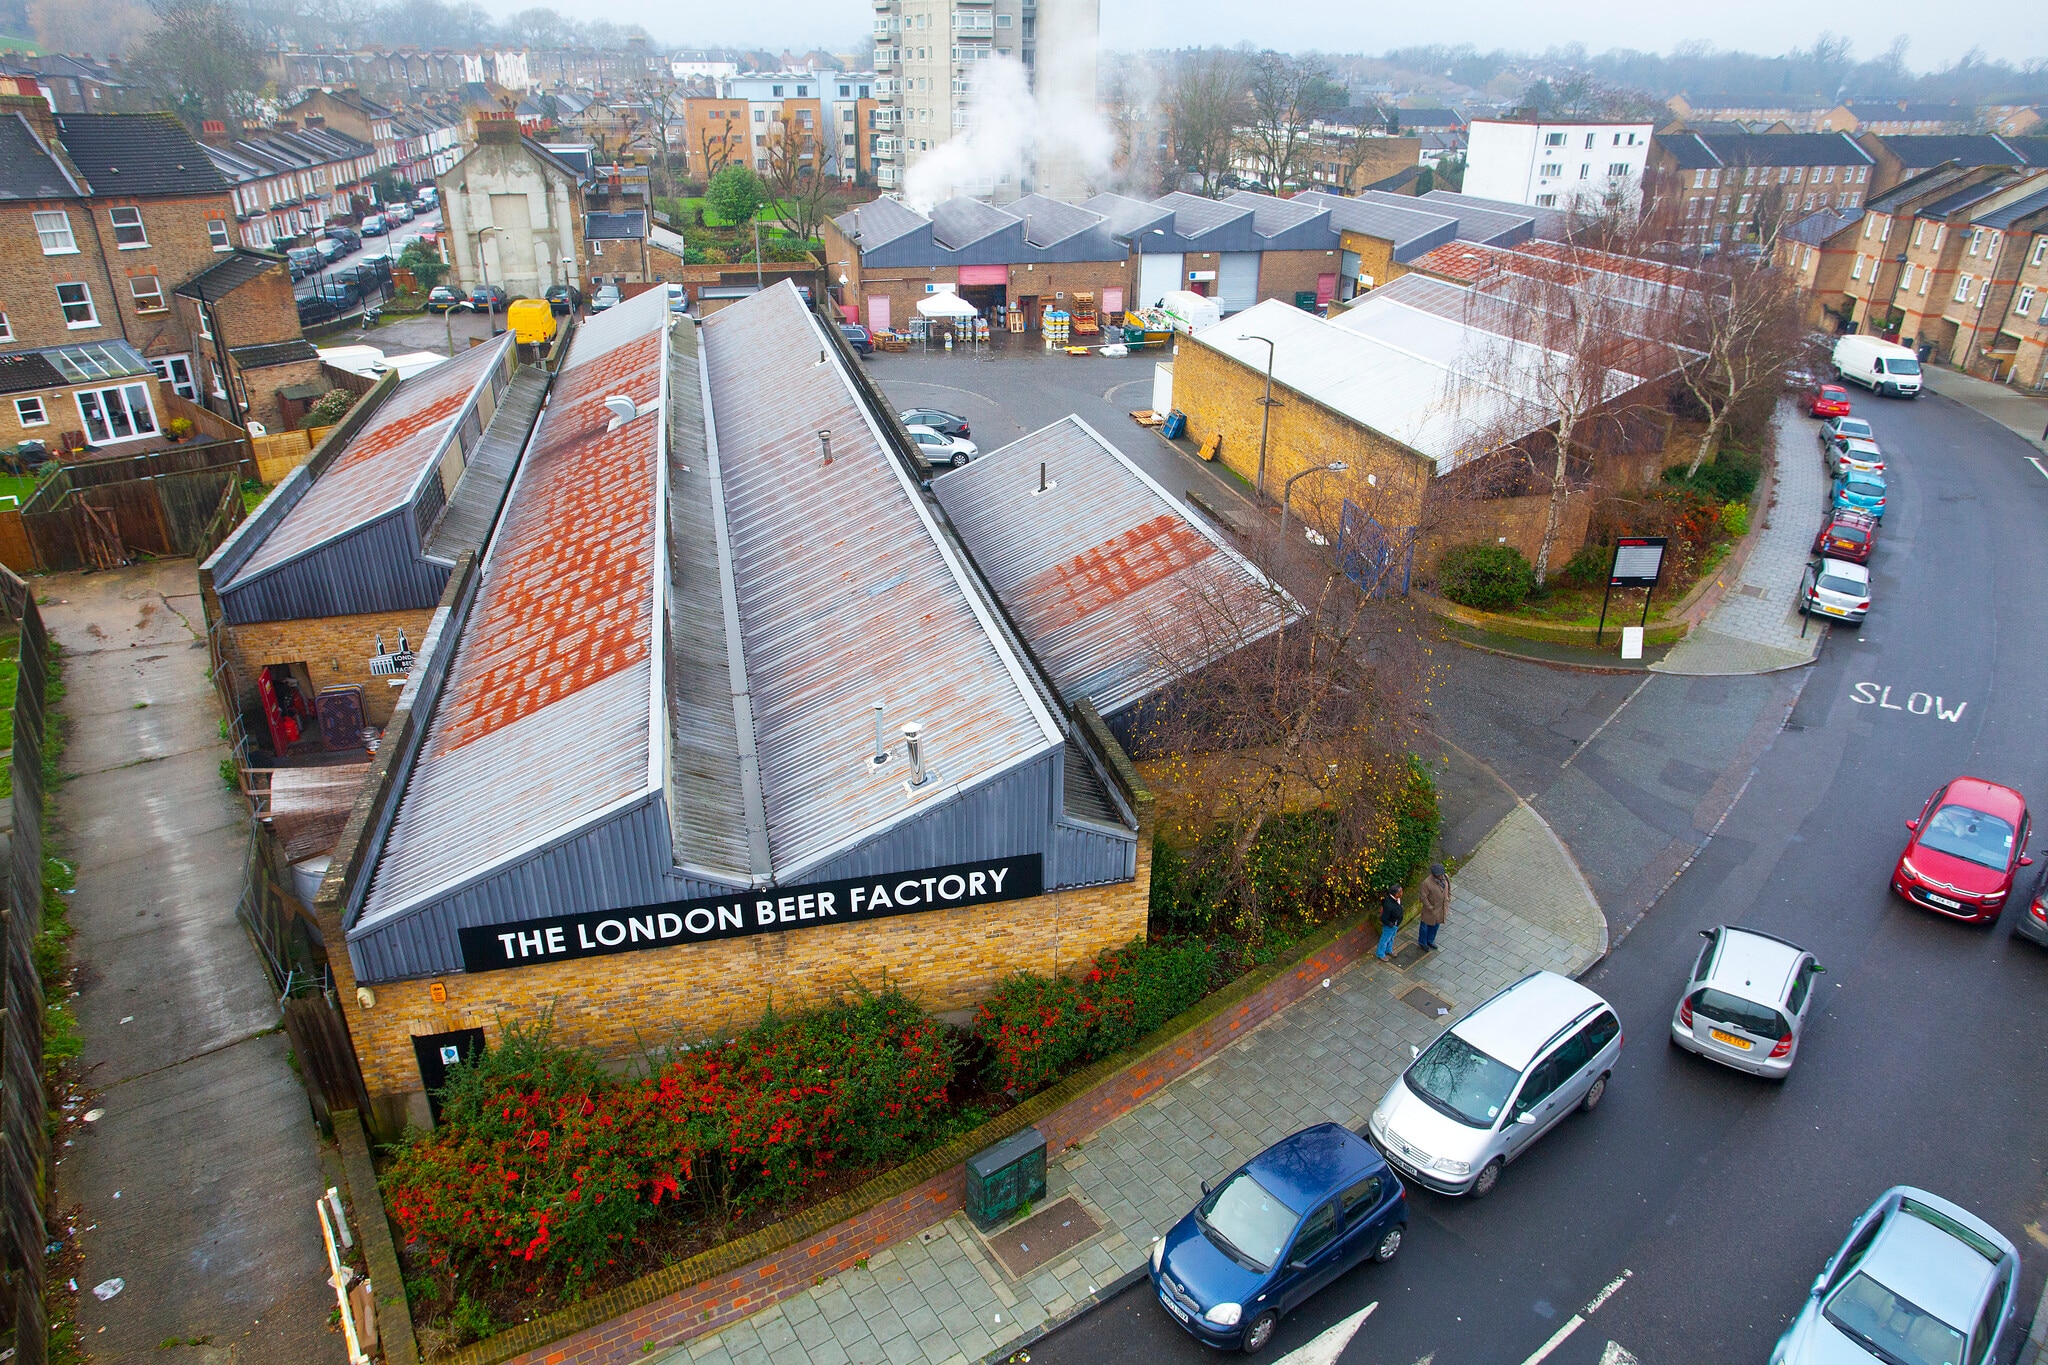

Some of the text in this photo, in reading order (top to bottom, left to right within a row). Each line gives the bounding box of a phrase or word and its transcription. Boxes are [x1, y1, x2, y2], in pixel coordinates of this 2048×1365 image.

[1850, 682, 1967, 722] SLOW
[497, 867, 1009, 959] THE LONDON BEER FACTORY
